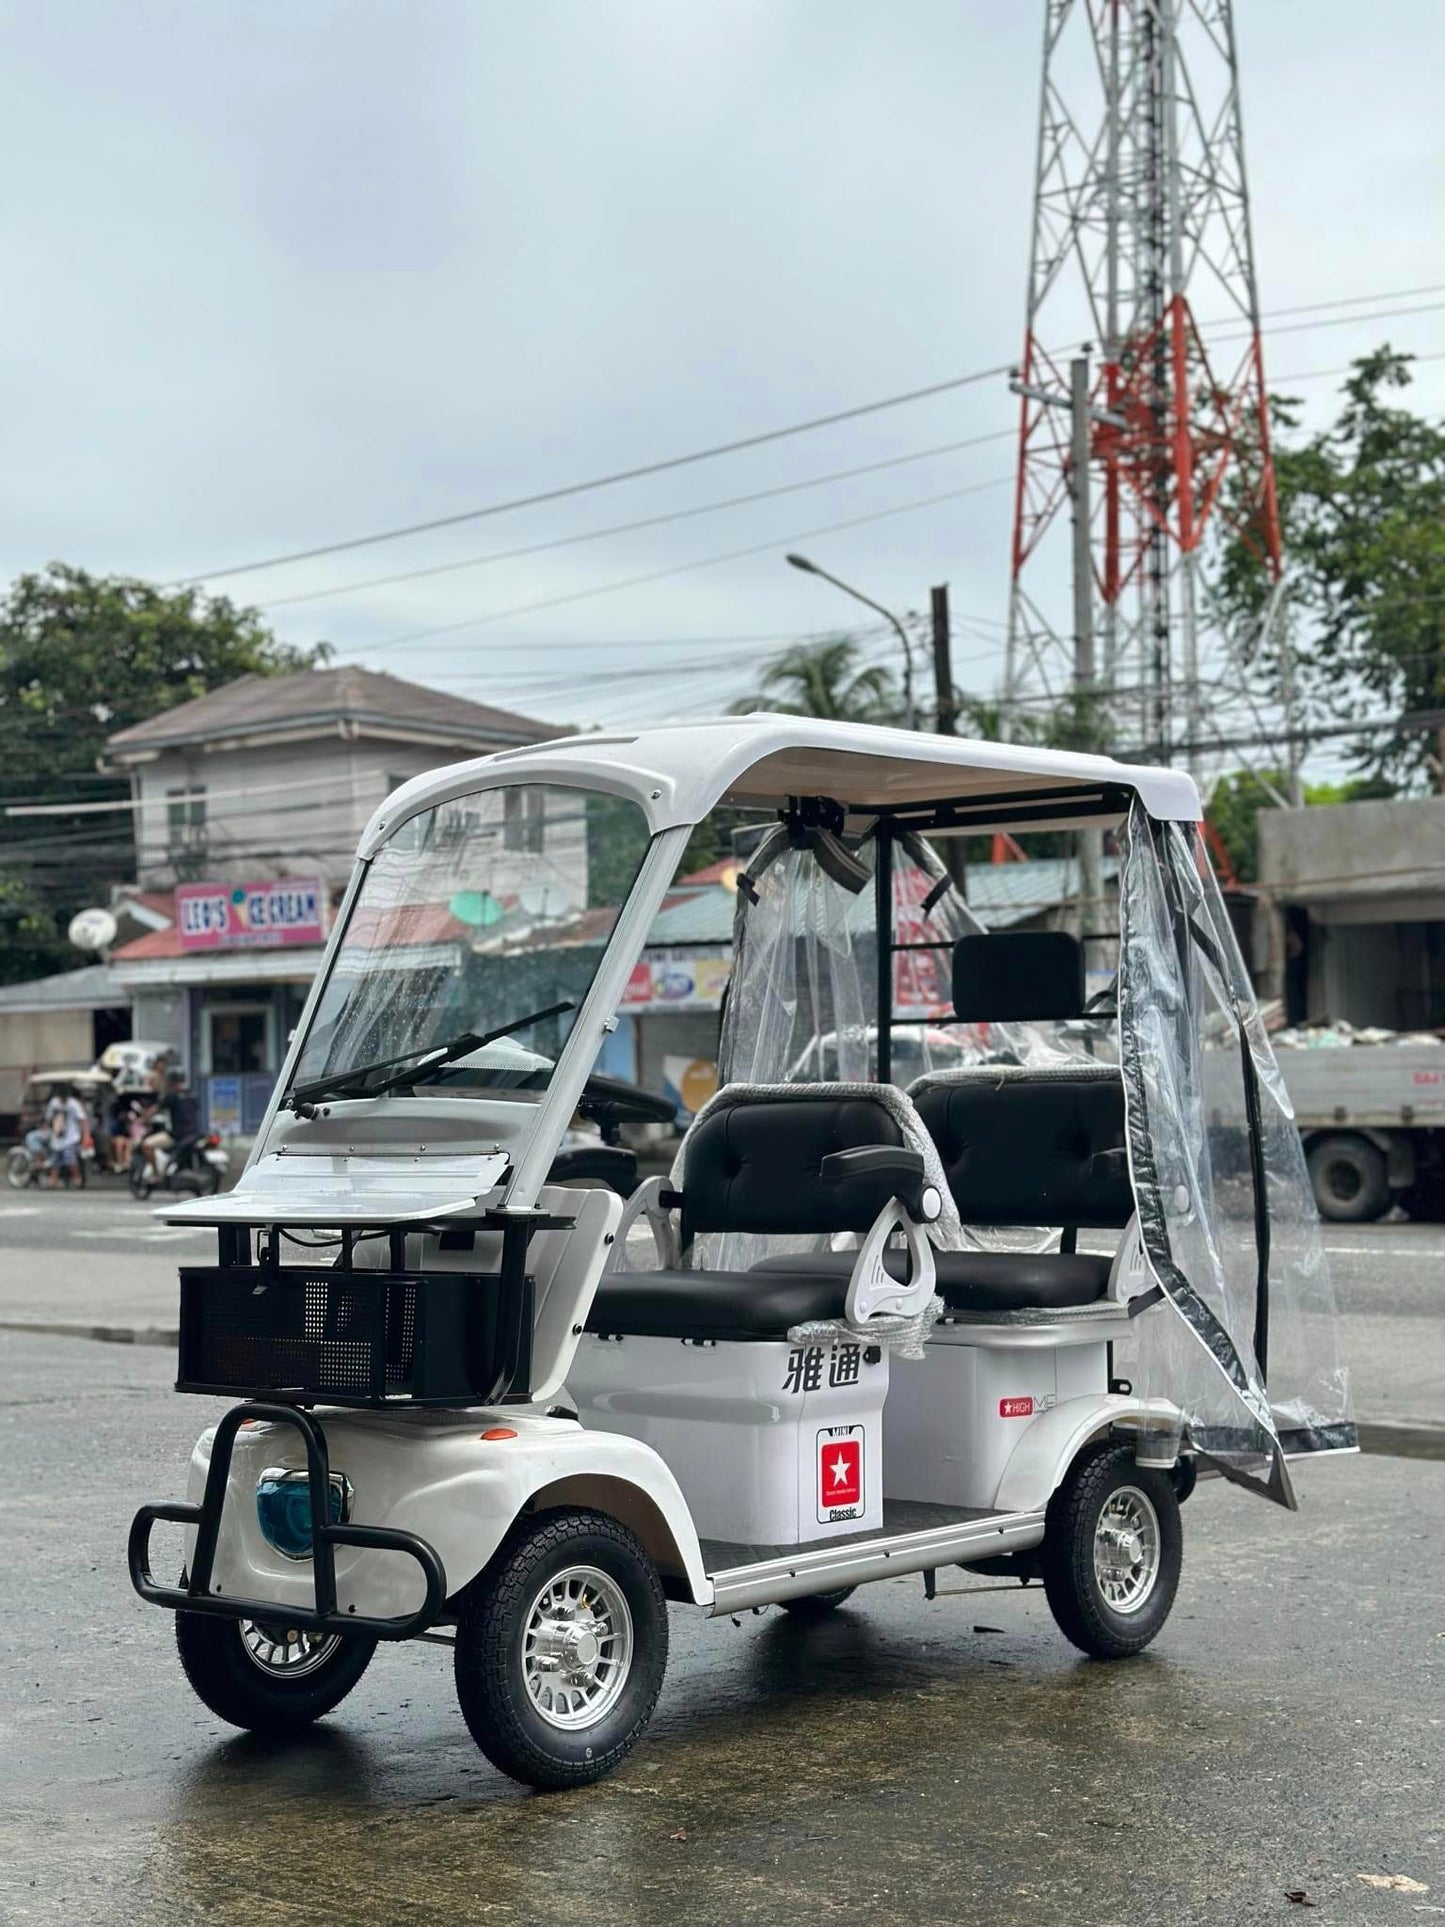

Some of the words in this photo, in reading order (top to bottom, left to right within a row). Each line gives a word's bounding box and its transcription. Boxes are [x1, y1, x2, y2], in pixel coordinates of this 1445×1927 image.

[782, 1343, 861, 1394] 雅通
[1012, 1401, 1031, 1414] HIGH
[829, 1506, 857, 1521] Classic
